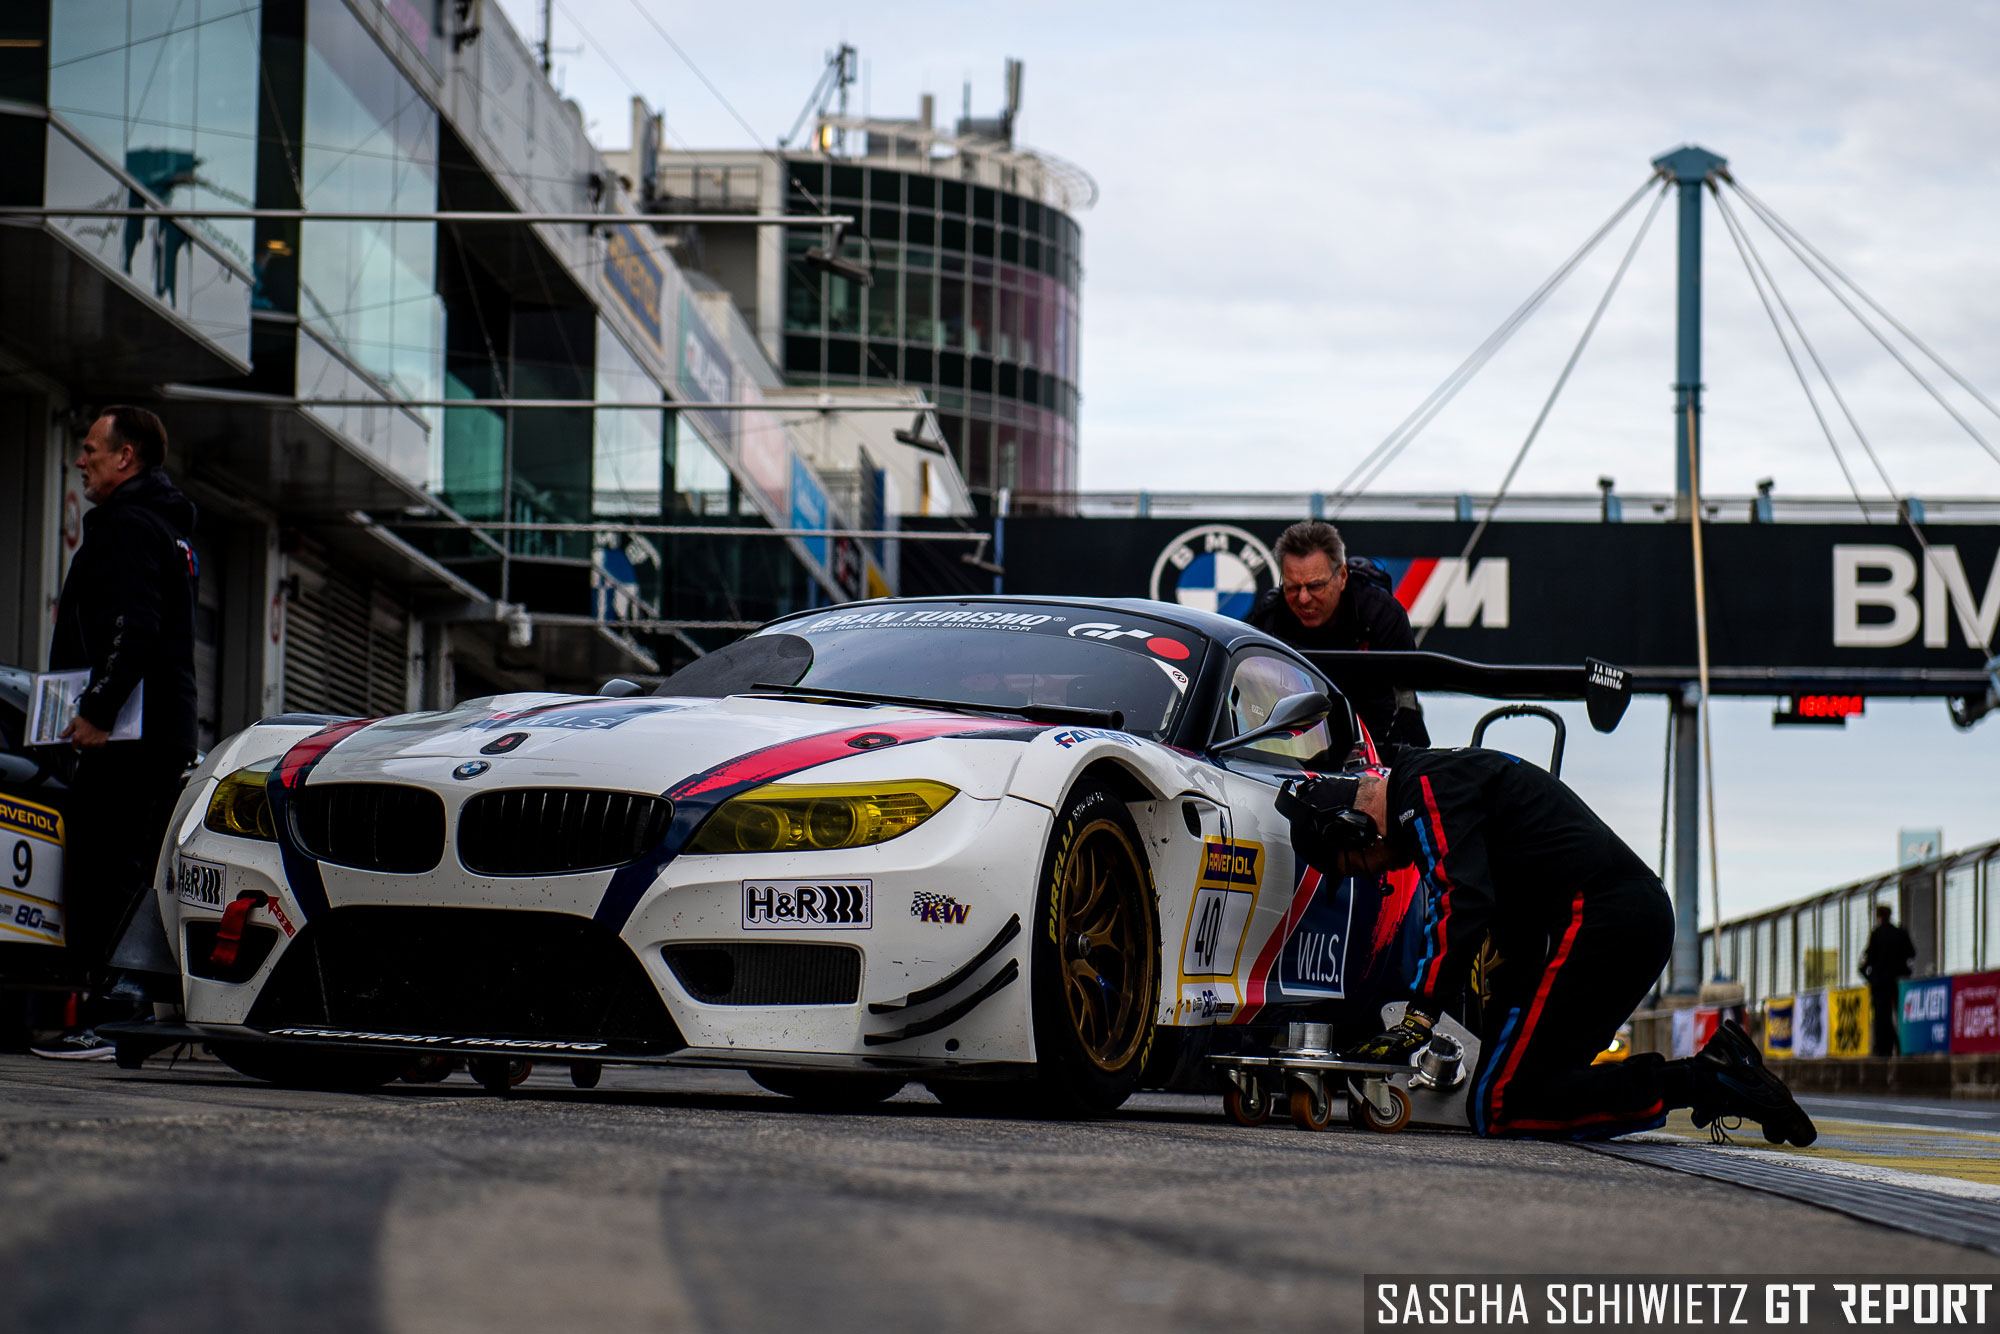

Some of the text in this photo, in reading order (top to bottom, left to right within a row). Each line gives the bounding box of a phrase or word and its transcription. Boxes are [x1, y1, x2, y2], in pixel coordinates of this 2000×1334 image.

[1169, 532, 1267, 571] BMW
[805, 621, 1032, 635] THE REAL DRIVING SIMULATOR
[810, 611, 904, 629] GRAN
[12, 839, 33, 889] 9
[178, 861, 202, 902] H&R
[1049, 819, 1073, 944] PIRELLI
[1208, 851, 1252, 875] RAVENOL
[747, 886, 824, 924] H&R
[920, 902, 972, 926] KW
[1194, 896, 1221, 967] 40
[1297, 931, 1339, 983] W.I.S.
